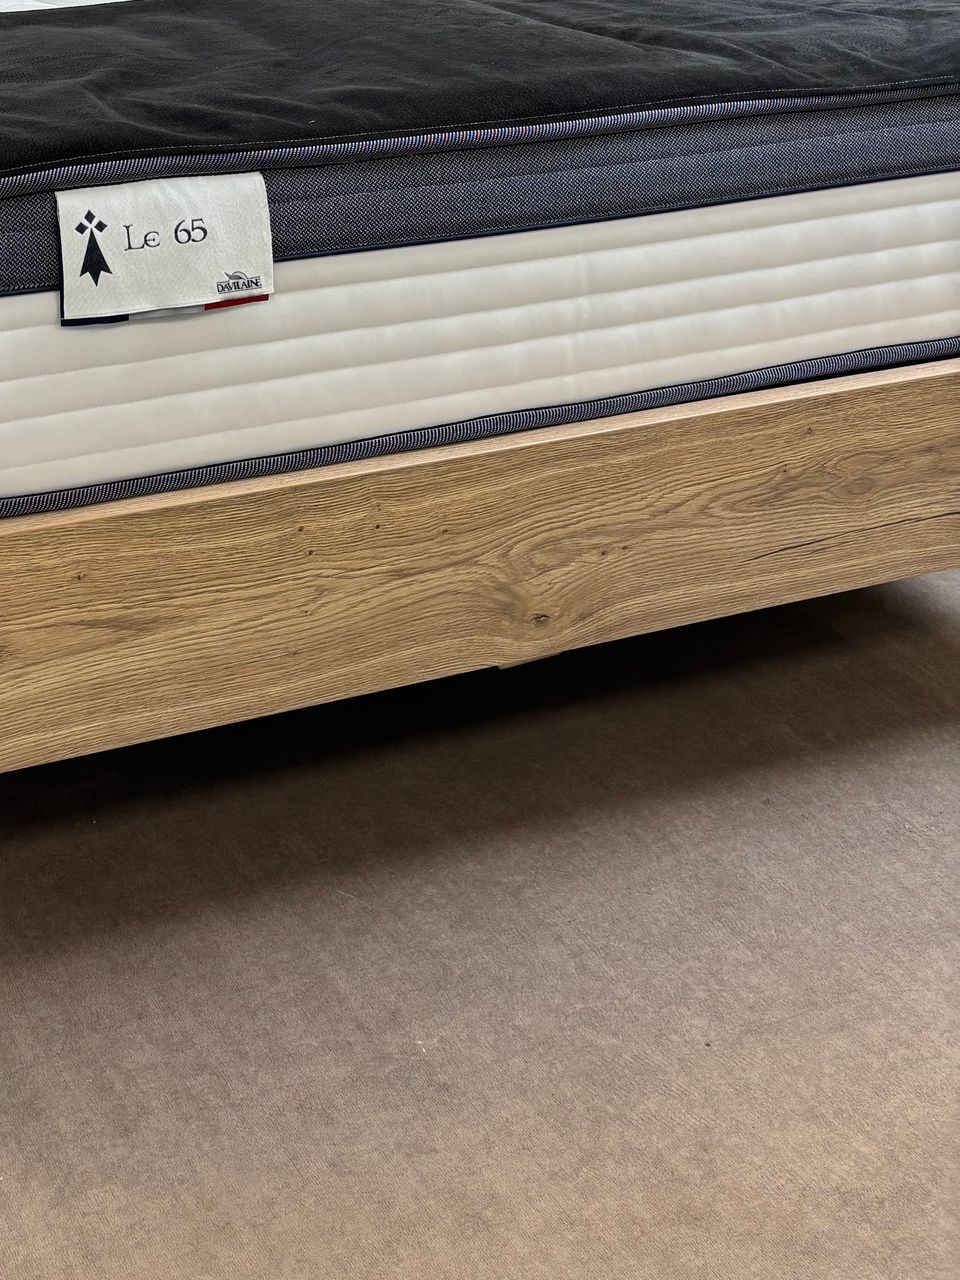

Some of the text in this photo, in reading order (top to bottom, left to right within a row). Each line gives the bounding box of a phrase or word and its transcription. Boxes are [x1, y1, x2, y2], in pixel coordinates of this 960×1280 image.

[123, 218, 208, 251] Le 65
[216, 278, 262, 293] DAVILAINE
